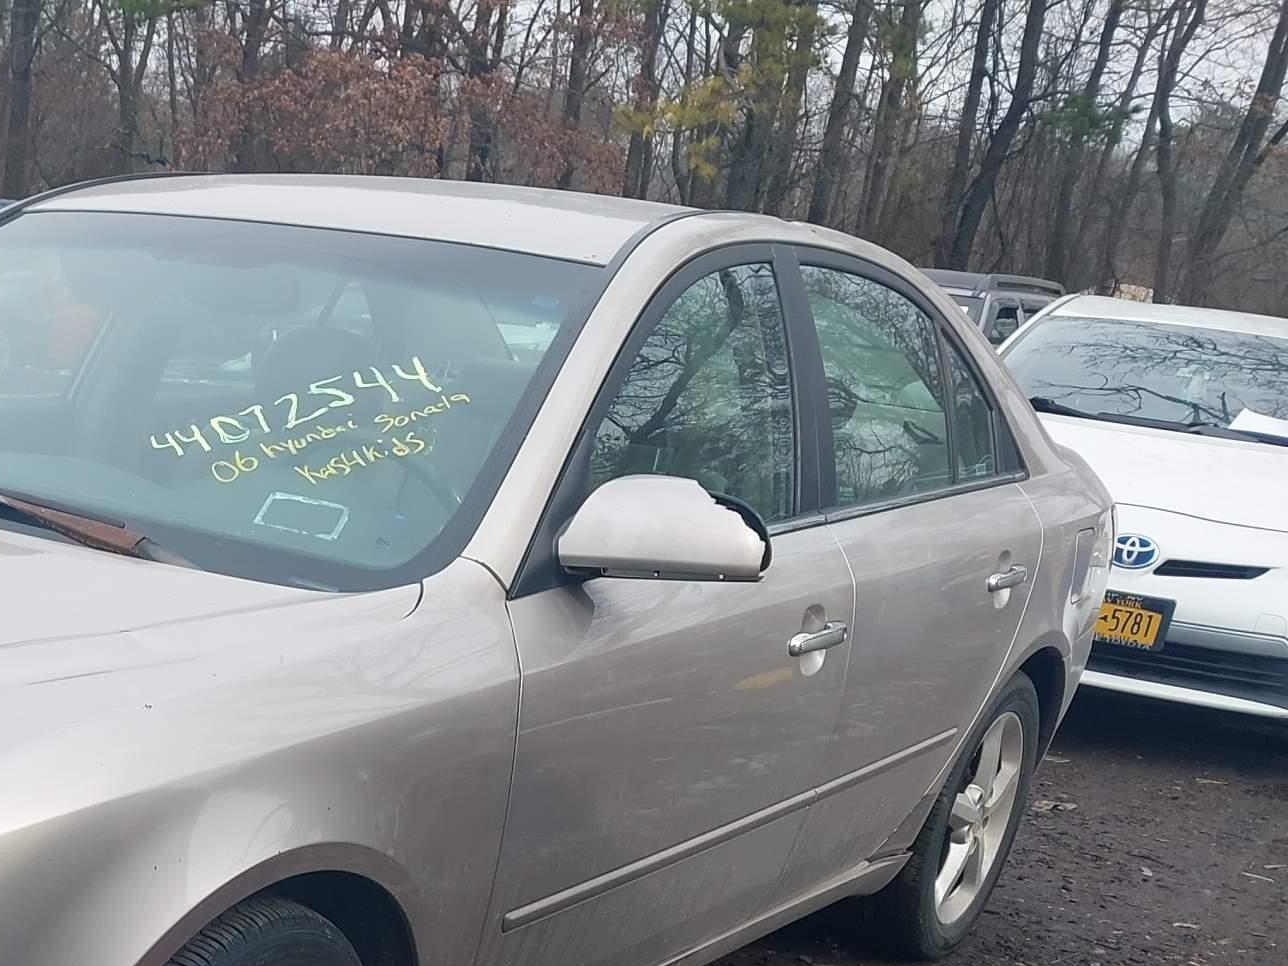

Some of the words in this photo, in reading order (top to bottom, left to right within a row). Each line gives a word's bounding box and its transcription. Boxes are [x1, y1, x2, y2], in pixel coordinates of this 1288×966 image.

[151, 356, 442, 456] 44072544
[212, 450, 259, 483] 06
[1108, 608, 1154, 638] 5781
